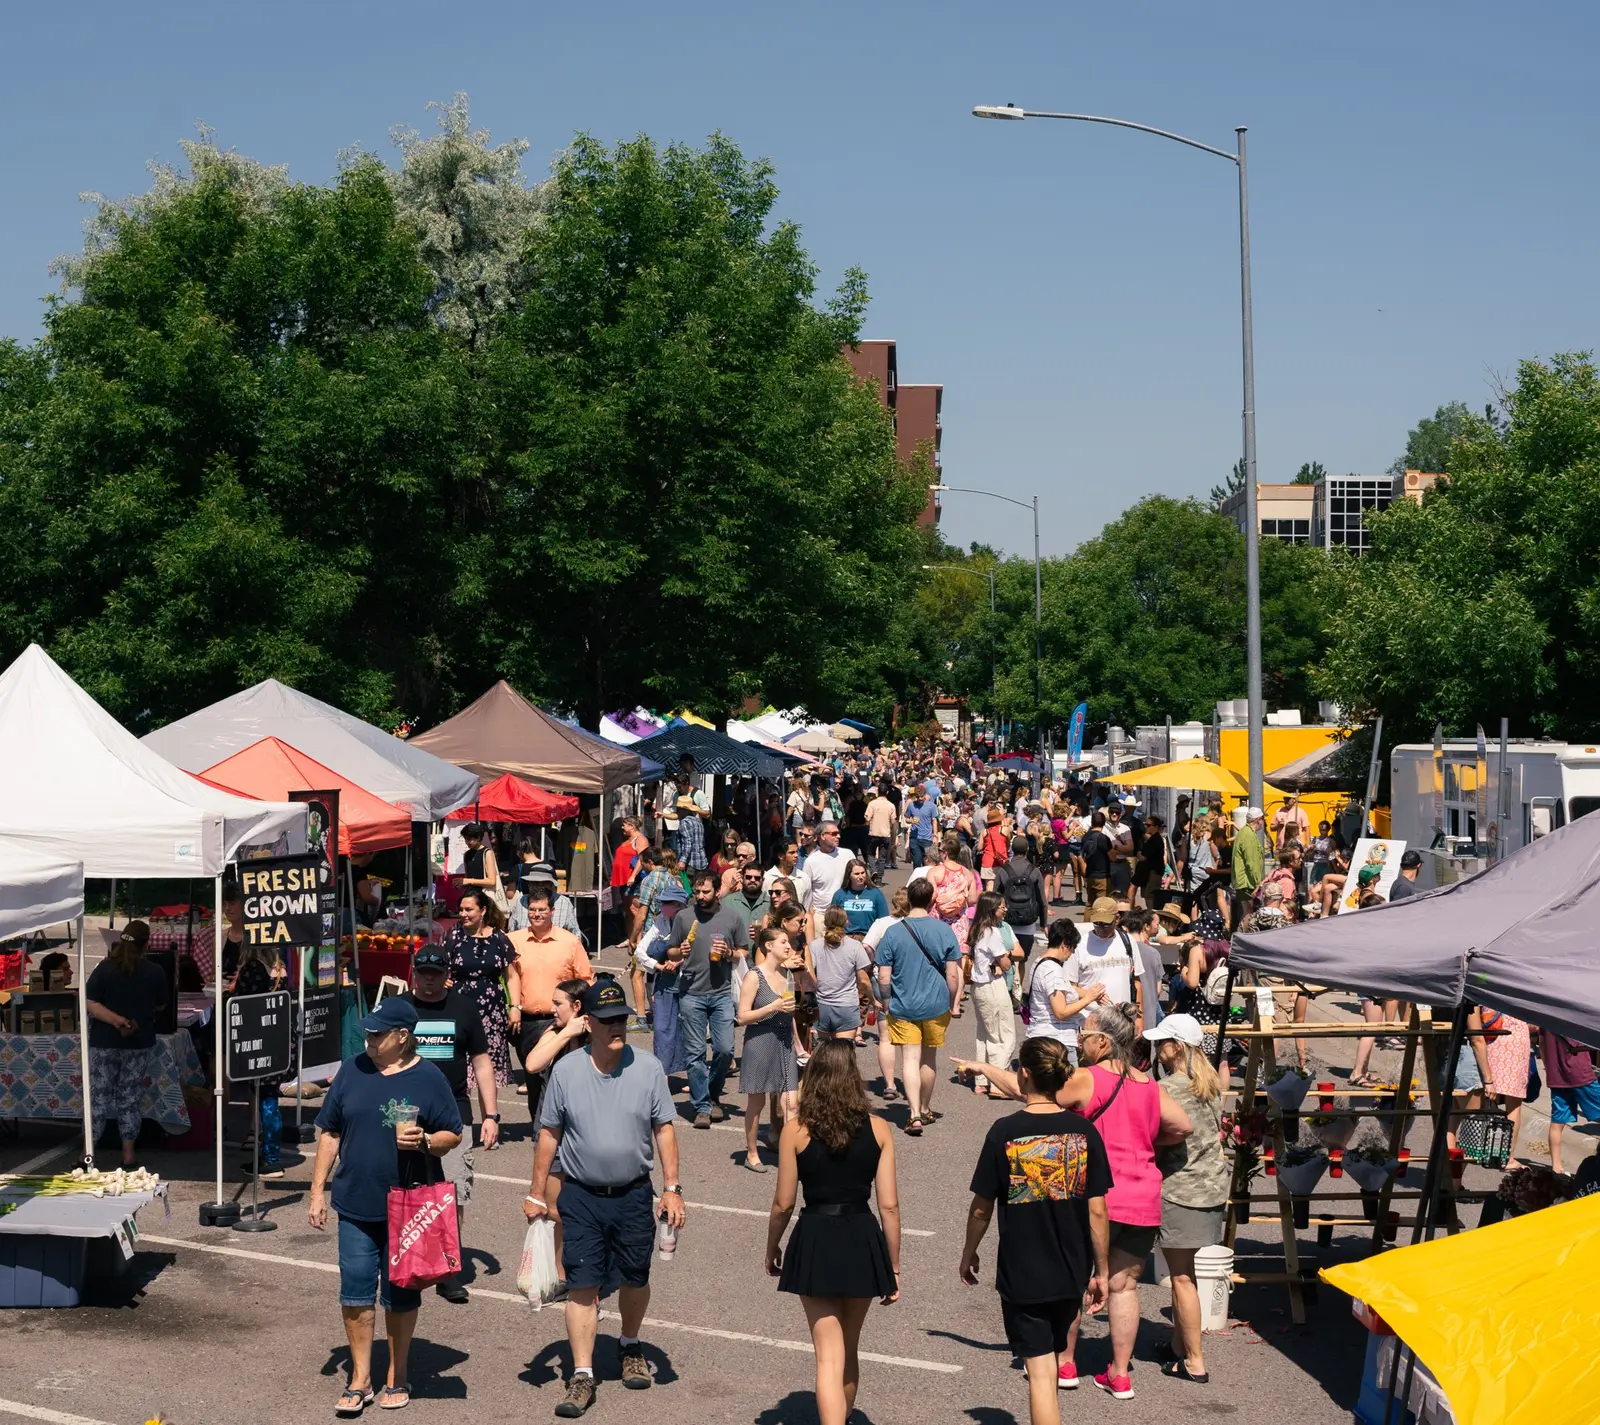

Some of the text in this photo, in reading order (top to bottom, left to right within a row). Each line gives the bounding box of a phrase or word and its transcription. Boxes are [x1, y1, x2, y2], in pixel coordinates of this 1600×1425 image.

[243, 868, 316, 894] FRESH
[244, 893, 318, 918] GROWN
[852, 902, 865, 910] fsy
[244, 921, 292, 944] TEA
[305, 1007, 329, 1018] MISSOULA
[305, 1023, 326, 1034] MUSEUM
[1586, 1180, 1600, 1192] CA
[391, 1193, 454, 1266] CARDINALS
